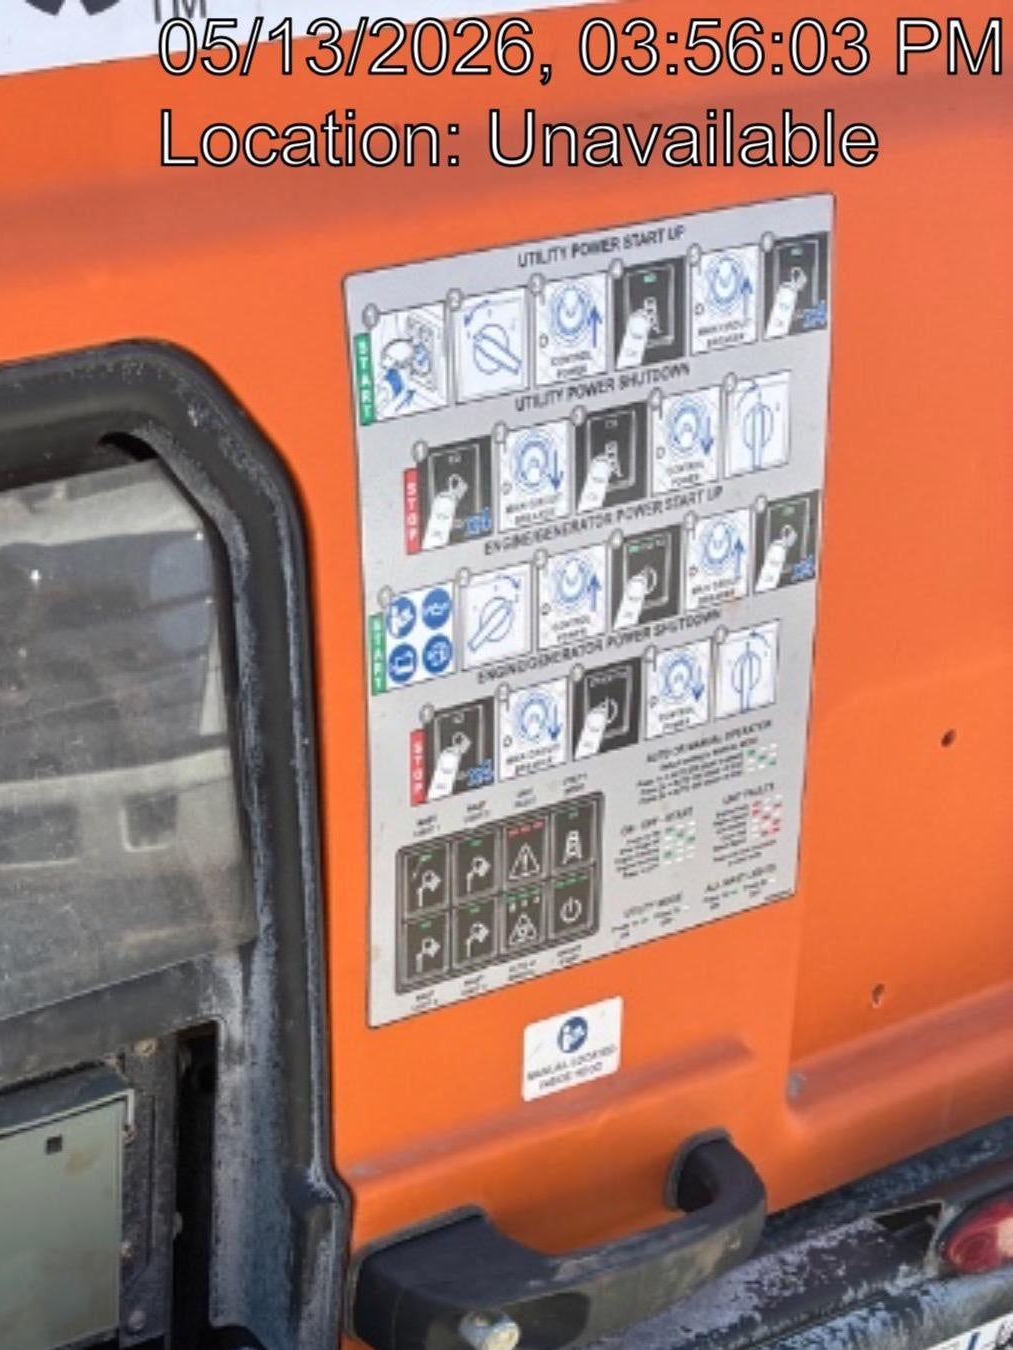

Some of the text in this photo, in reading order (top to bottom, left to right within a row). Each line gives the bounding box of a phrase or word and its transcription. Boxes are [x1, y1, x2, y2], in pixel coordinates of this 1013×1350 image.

[517, 225, 685, 268] UTILITY POWER START UP
[356, 336, 370, 419] START
[515, 362, 690, 412] UTILITY POWER SHUTDOWN
[405, 481, 419, 541] STOP
[615, 500, 663, 522] POWER
[664, 490, 702, 512] START
[707, 485, 723, 502] UP
[606, 626, 651, 649] POWER
[653, 609, 721, 637] SHUTDOWN
